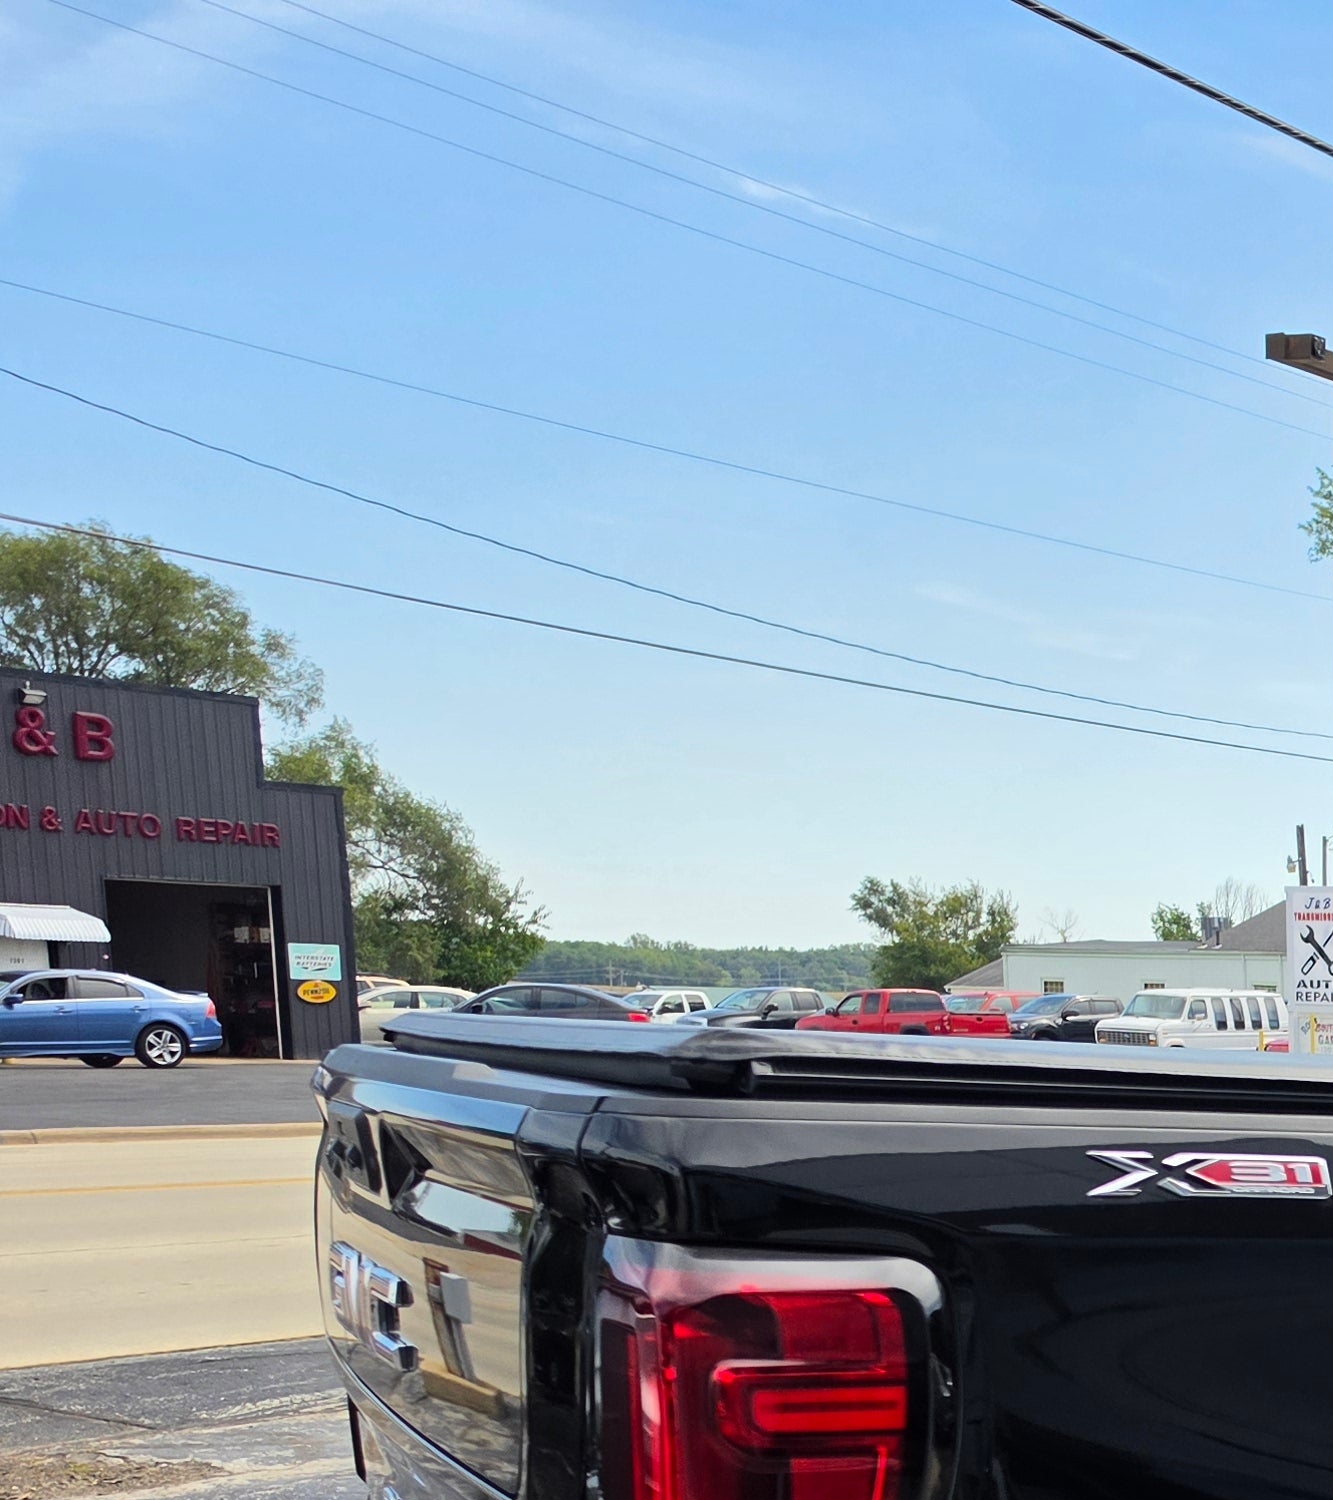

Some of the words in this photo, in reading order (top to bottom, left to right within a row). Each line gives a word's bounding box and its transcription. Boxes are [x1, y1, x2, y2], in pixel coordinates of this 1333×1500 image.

[13, 706, 58, 756] &
[72, 711, 115, 762] B
[40, 806, 63, 832] &
[75, 808, 162, 839] AUTO
[175, 816, 281, 848] REPAIR
